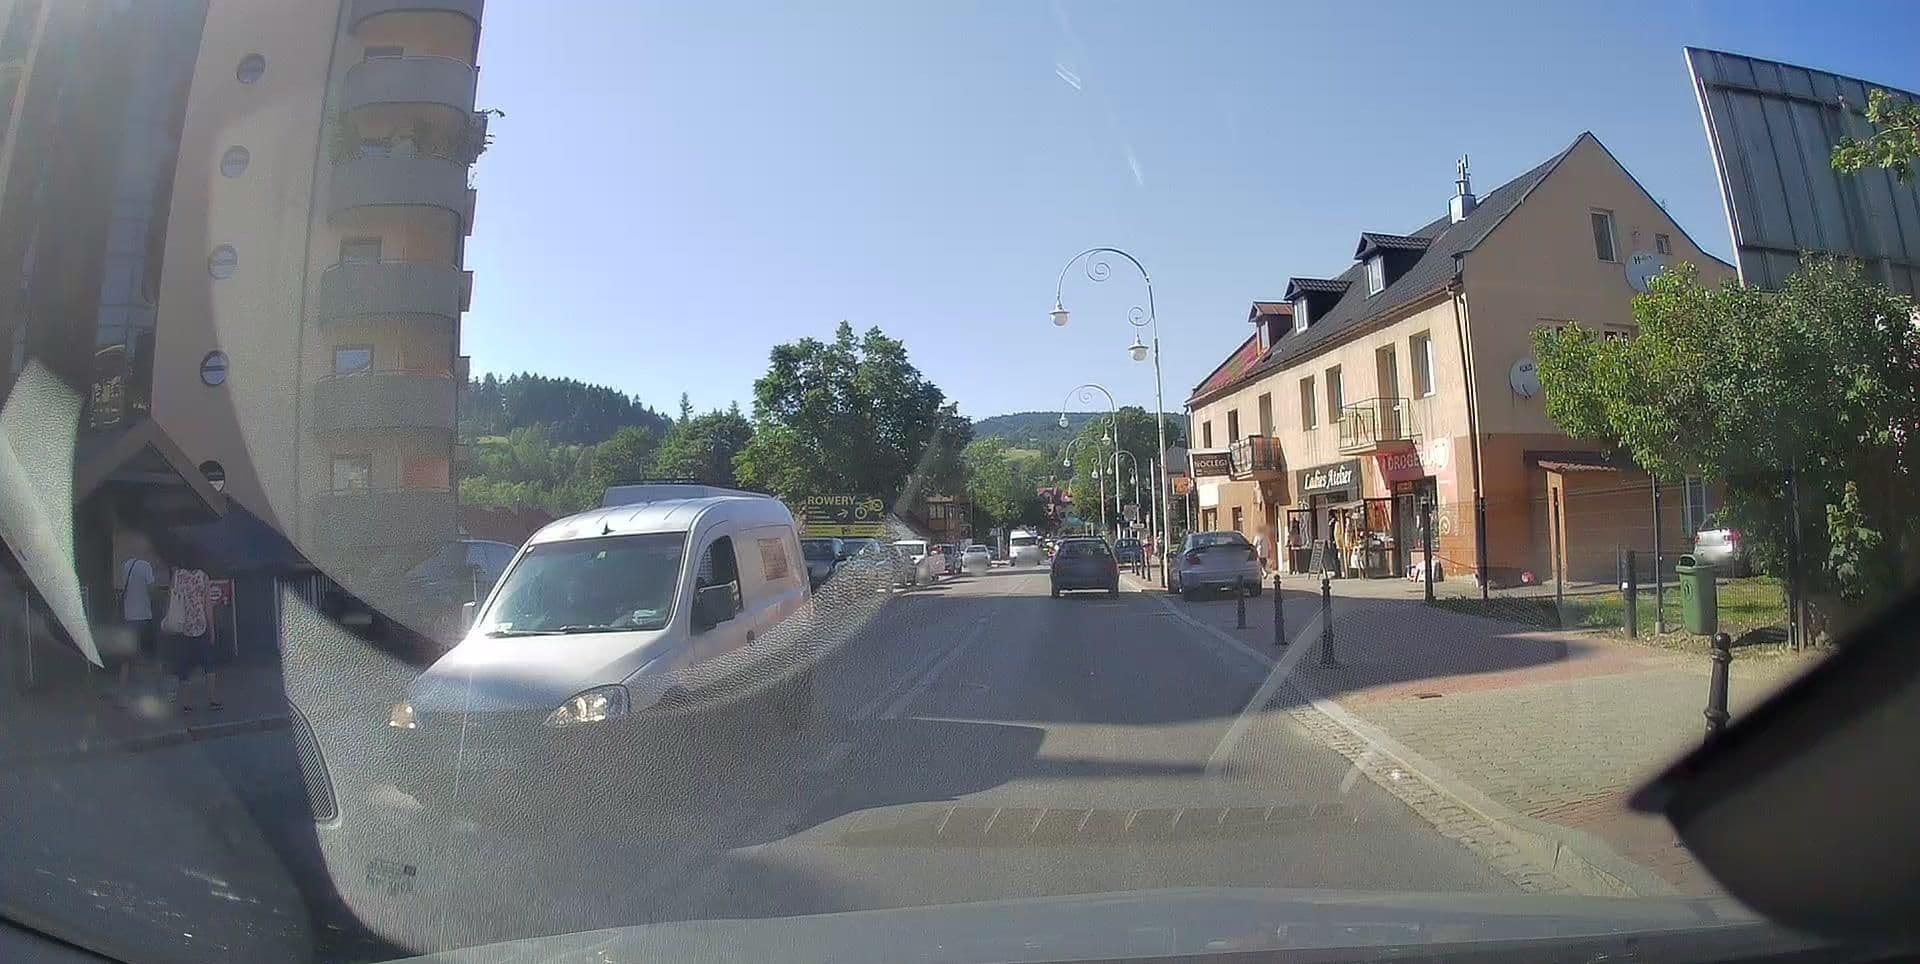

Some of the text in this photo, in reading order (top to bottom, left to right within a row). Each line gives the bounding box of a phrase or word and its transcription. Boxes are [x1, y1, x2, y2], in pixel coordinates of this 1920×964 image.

[1194, 459, 1227, 468] NOCLEGI
[1304, 464, 1352, 490] Ladies Atelier
[807, 495, 856, 506] ROWERY
